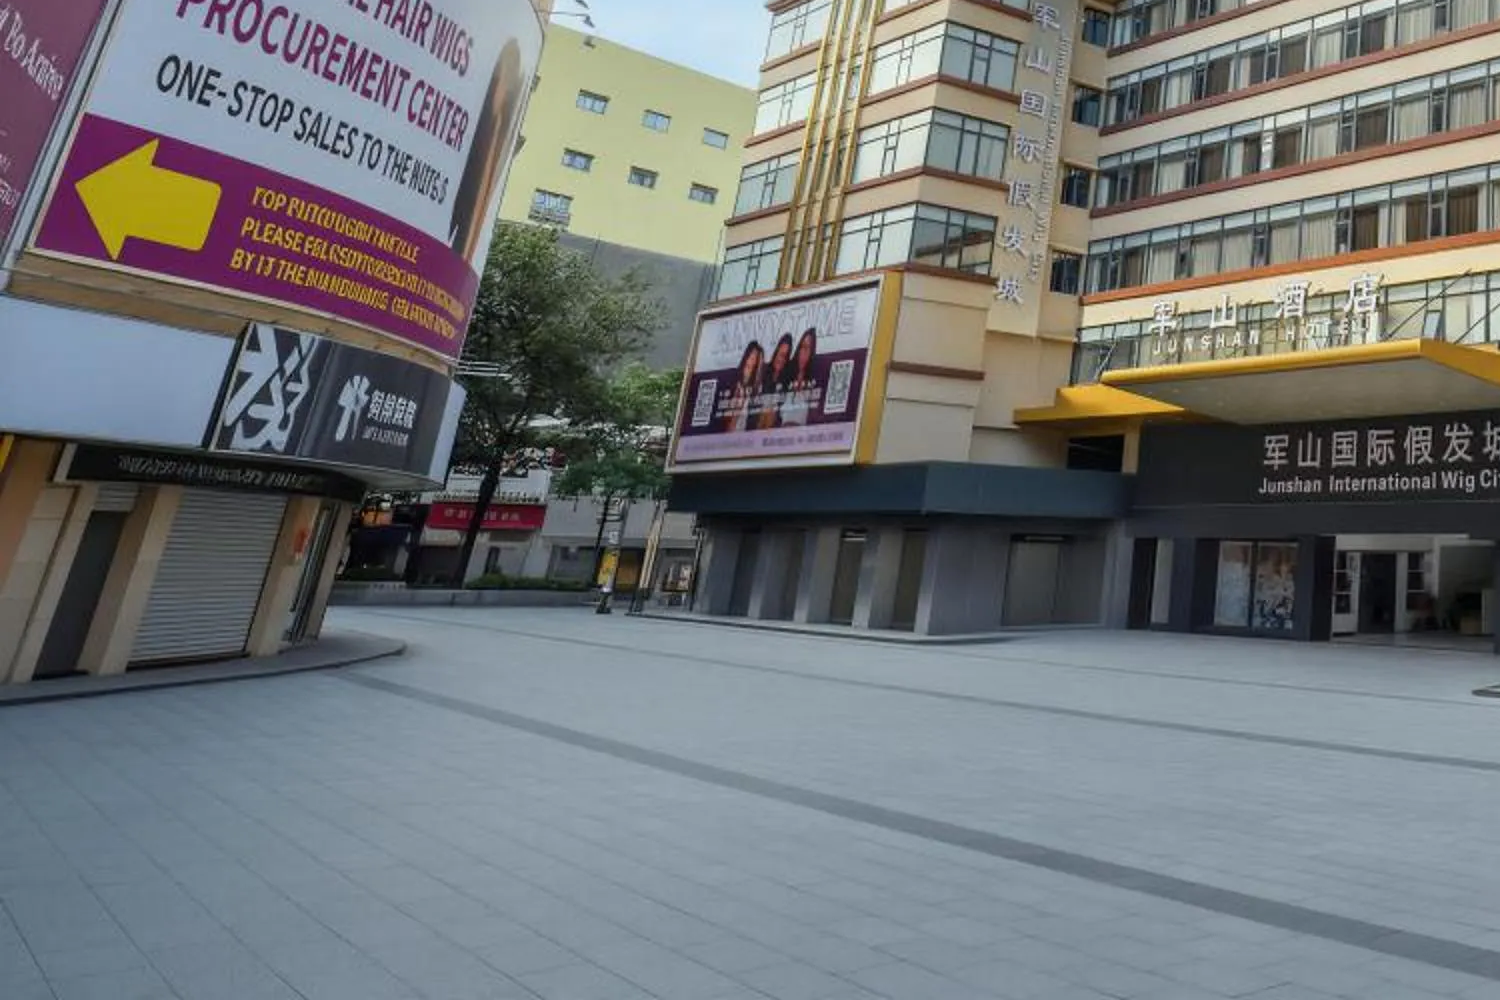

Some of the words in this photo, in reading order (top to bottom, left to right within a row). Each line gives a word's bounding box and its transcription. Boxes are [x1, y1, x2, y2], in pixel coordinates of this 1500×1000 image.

[430, 12, 475, 78] WIGS
[156, 54, 295, 134] ONE-STOP
[293, 106, 360, 160] SALES
[357, 132, 383, 171] TO
[381, 143, 412, 186] THE
[406, 79, 470, 153] CENTER
[240, 216, 305, 253] PLEASE
[1148, 273, 1384, 338] 军山酒店
[1153, 329, 1260, 355] JUNSHAN
[1258, 476, 1322, 495] Junshan
[1329, 471, 1437, 494] International
[1441, 469, 1476, 493] Wig
